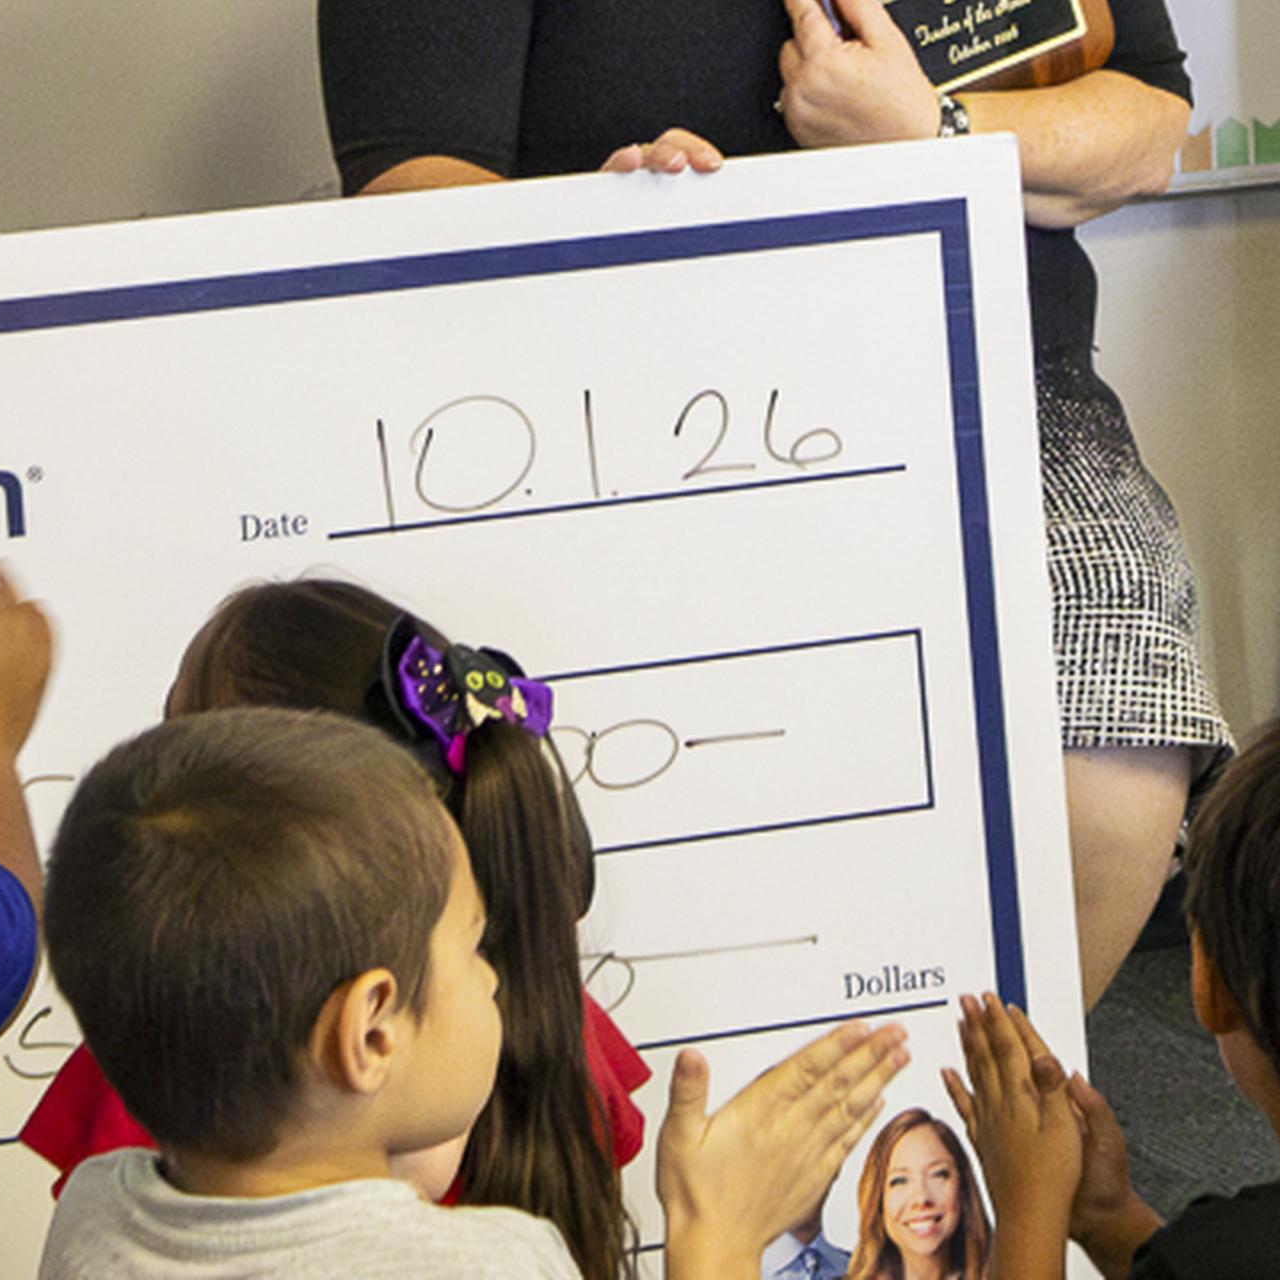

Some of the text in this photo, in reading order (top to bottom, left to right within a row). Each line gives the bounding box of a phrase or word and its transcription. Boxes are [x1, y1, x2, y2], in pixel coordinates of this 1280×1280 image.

[914, 15, 961, 47] Teacher
[963, 5, 975, 34] of
[948, 35, 993, 65] October
[238, 513, 309, 543] Date
[843, 962, 946, 1001] Dollars
